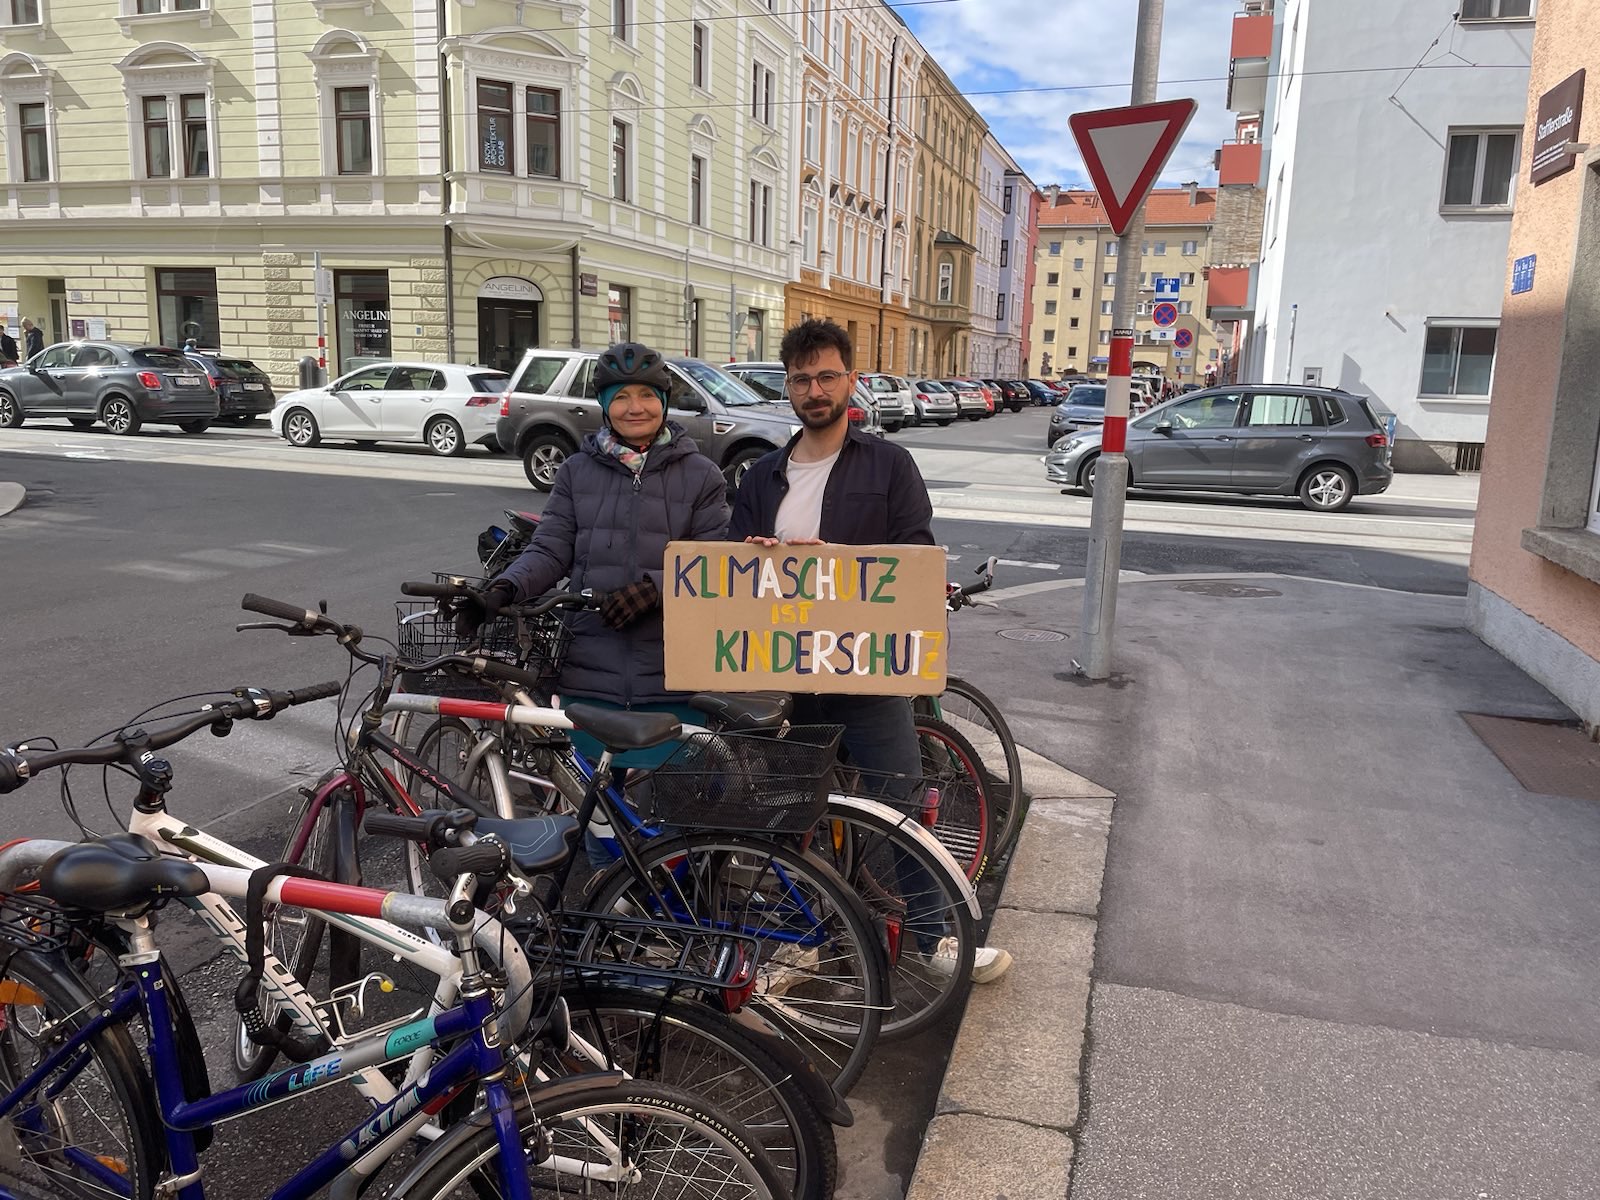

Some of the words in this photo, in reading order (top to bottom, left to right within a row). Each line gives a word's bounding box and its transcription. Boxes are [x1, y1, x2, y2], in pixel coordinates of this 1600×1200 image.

[1538, 107, 1574, 142] Stafflerstraße
[485, 283, 533, 293] ANGELINI
[342, 310, 391, 321] ANGELINI
[674, 555, 900, 603] KLIMASCHUTZ
[771, 601, 815, 624] IST
[714, 630, 944, 680] KINDERSCHUTZ
[975, 855, 989, 882] MAXXIS
[393, 1030, 422, 1048] FORCE
[288, 1057, 343, 1092] LIFE
[626, 1095, 693, 1114] SCHWALBE
[358, 1086, 422, 1151] KTM
